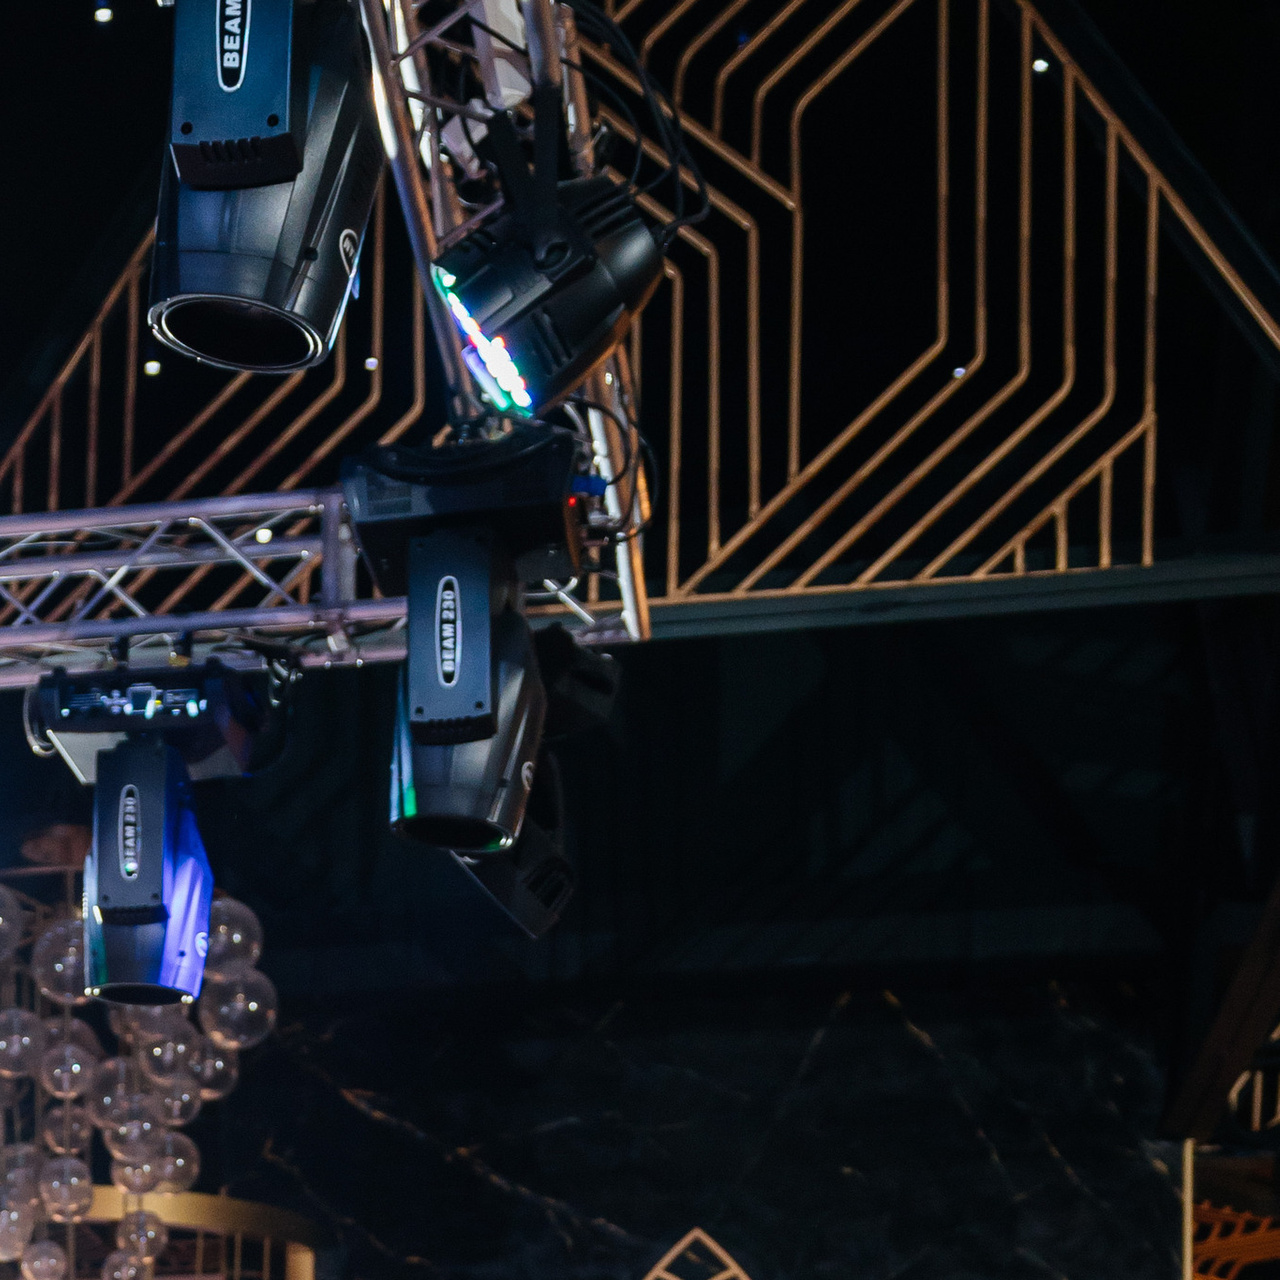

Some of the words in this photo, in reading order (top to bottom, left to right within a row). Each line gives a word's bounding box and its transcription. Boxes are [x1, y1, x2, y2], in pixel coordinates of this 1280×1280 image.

[223, 0, 241, 68] BEAM
[442, 590, 455, 620] 230
[442, 623, 455, 672] BEAM
